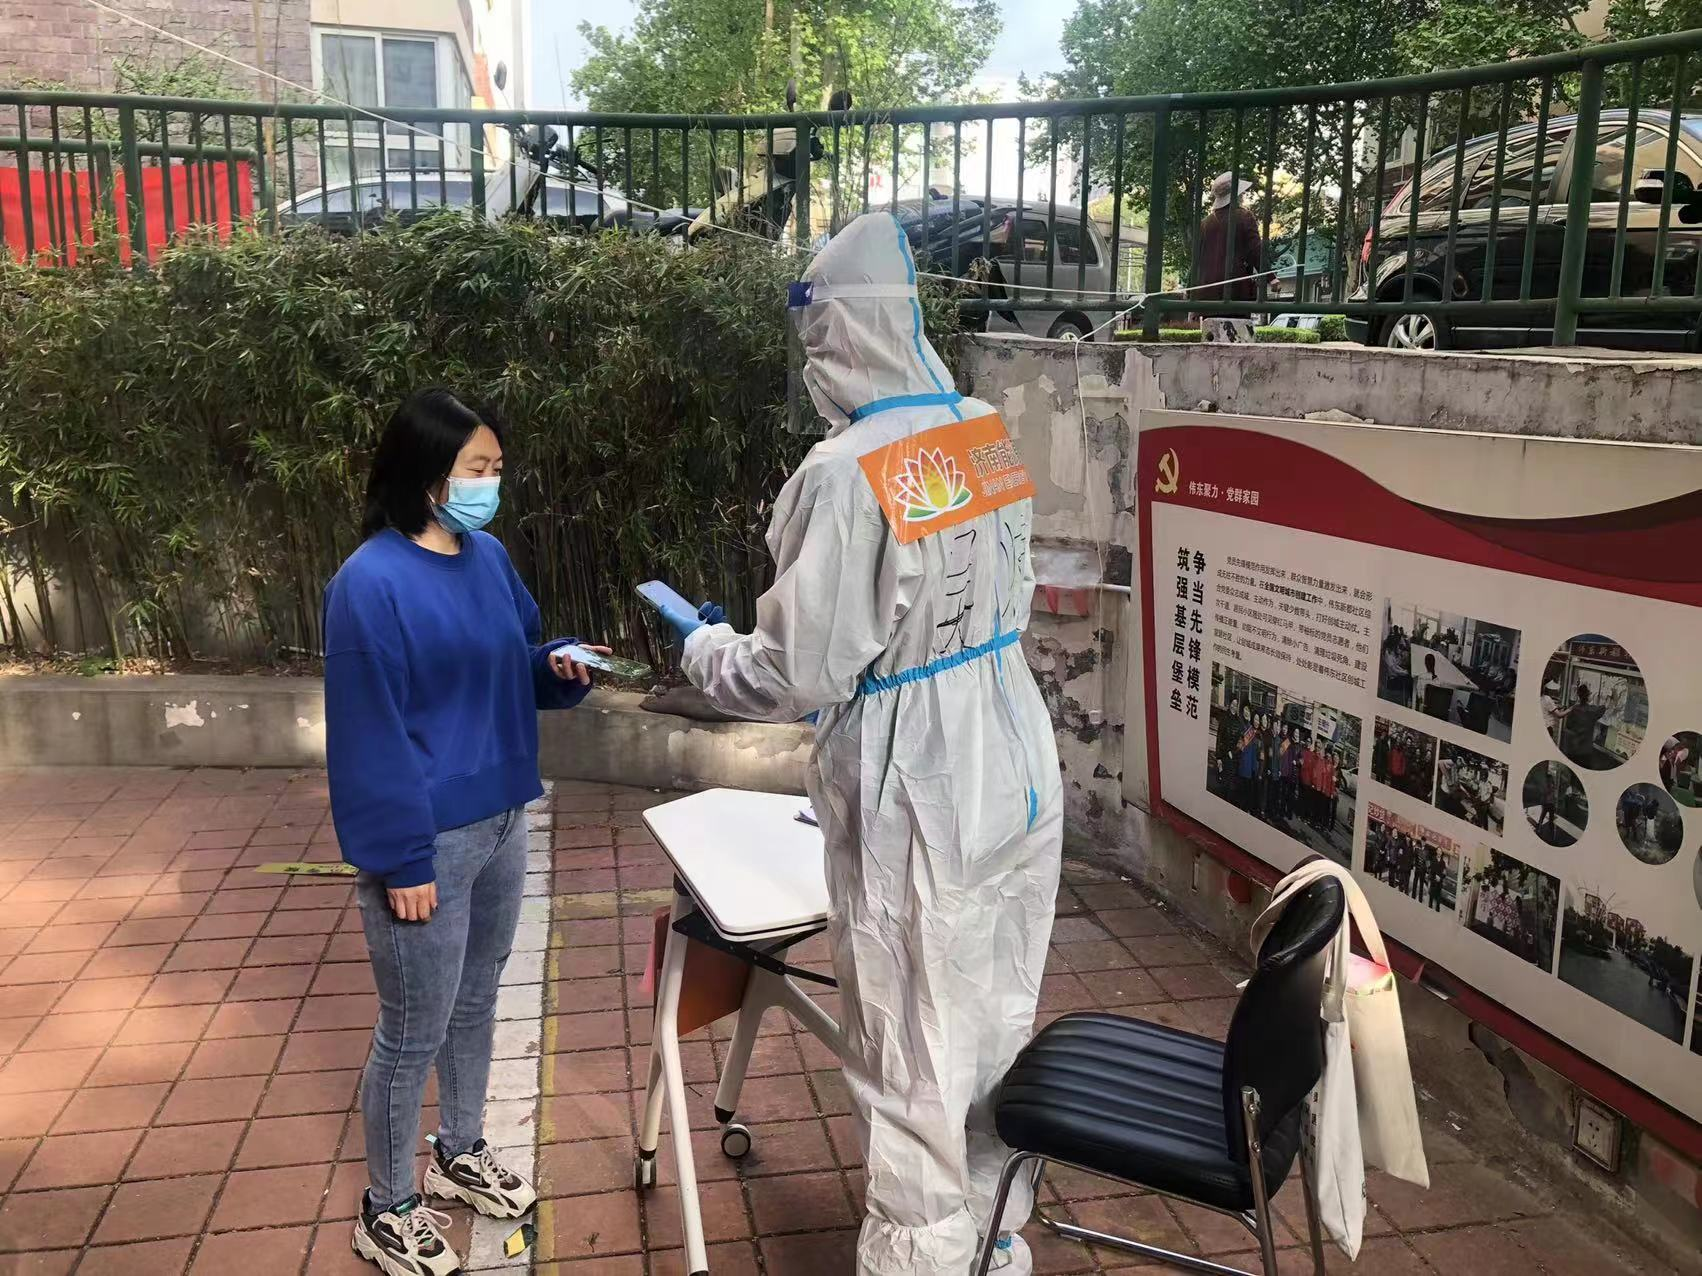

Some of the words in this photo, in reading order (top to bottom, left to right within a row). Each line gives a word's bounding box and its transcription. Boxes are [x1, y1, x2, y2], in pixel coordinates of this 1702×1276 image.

[1189, 481, 1260, 507] 伟东聚力·党群家园
[1170, 547, 1190, 712] 筑强基层堡垒
[1186, 550, 1206, 720] 争当先锋模范
